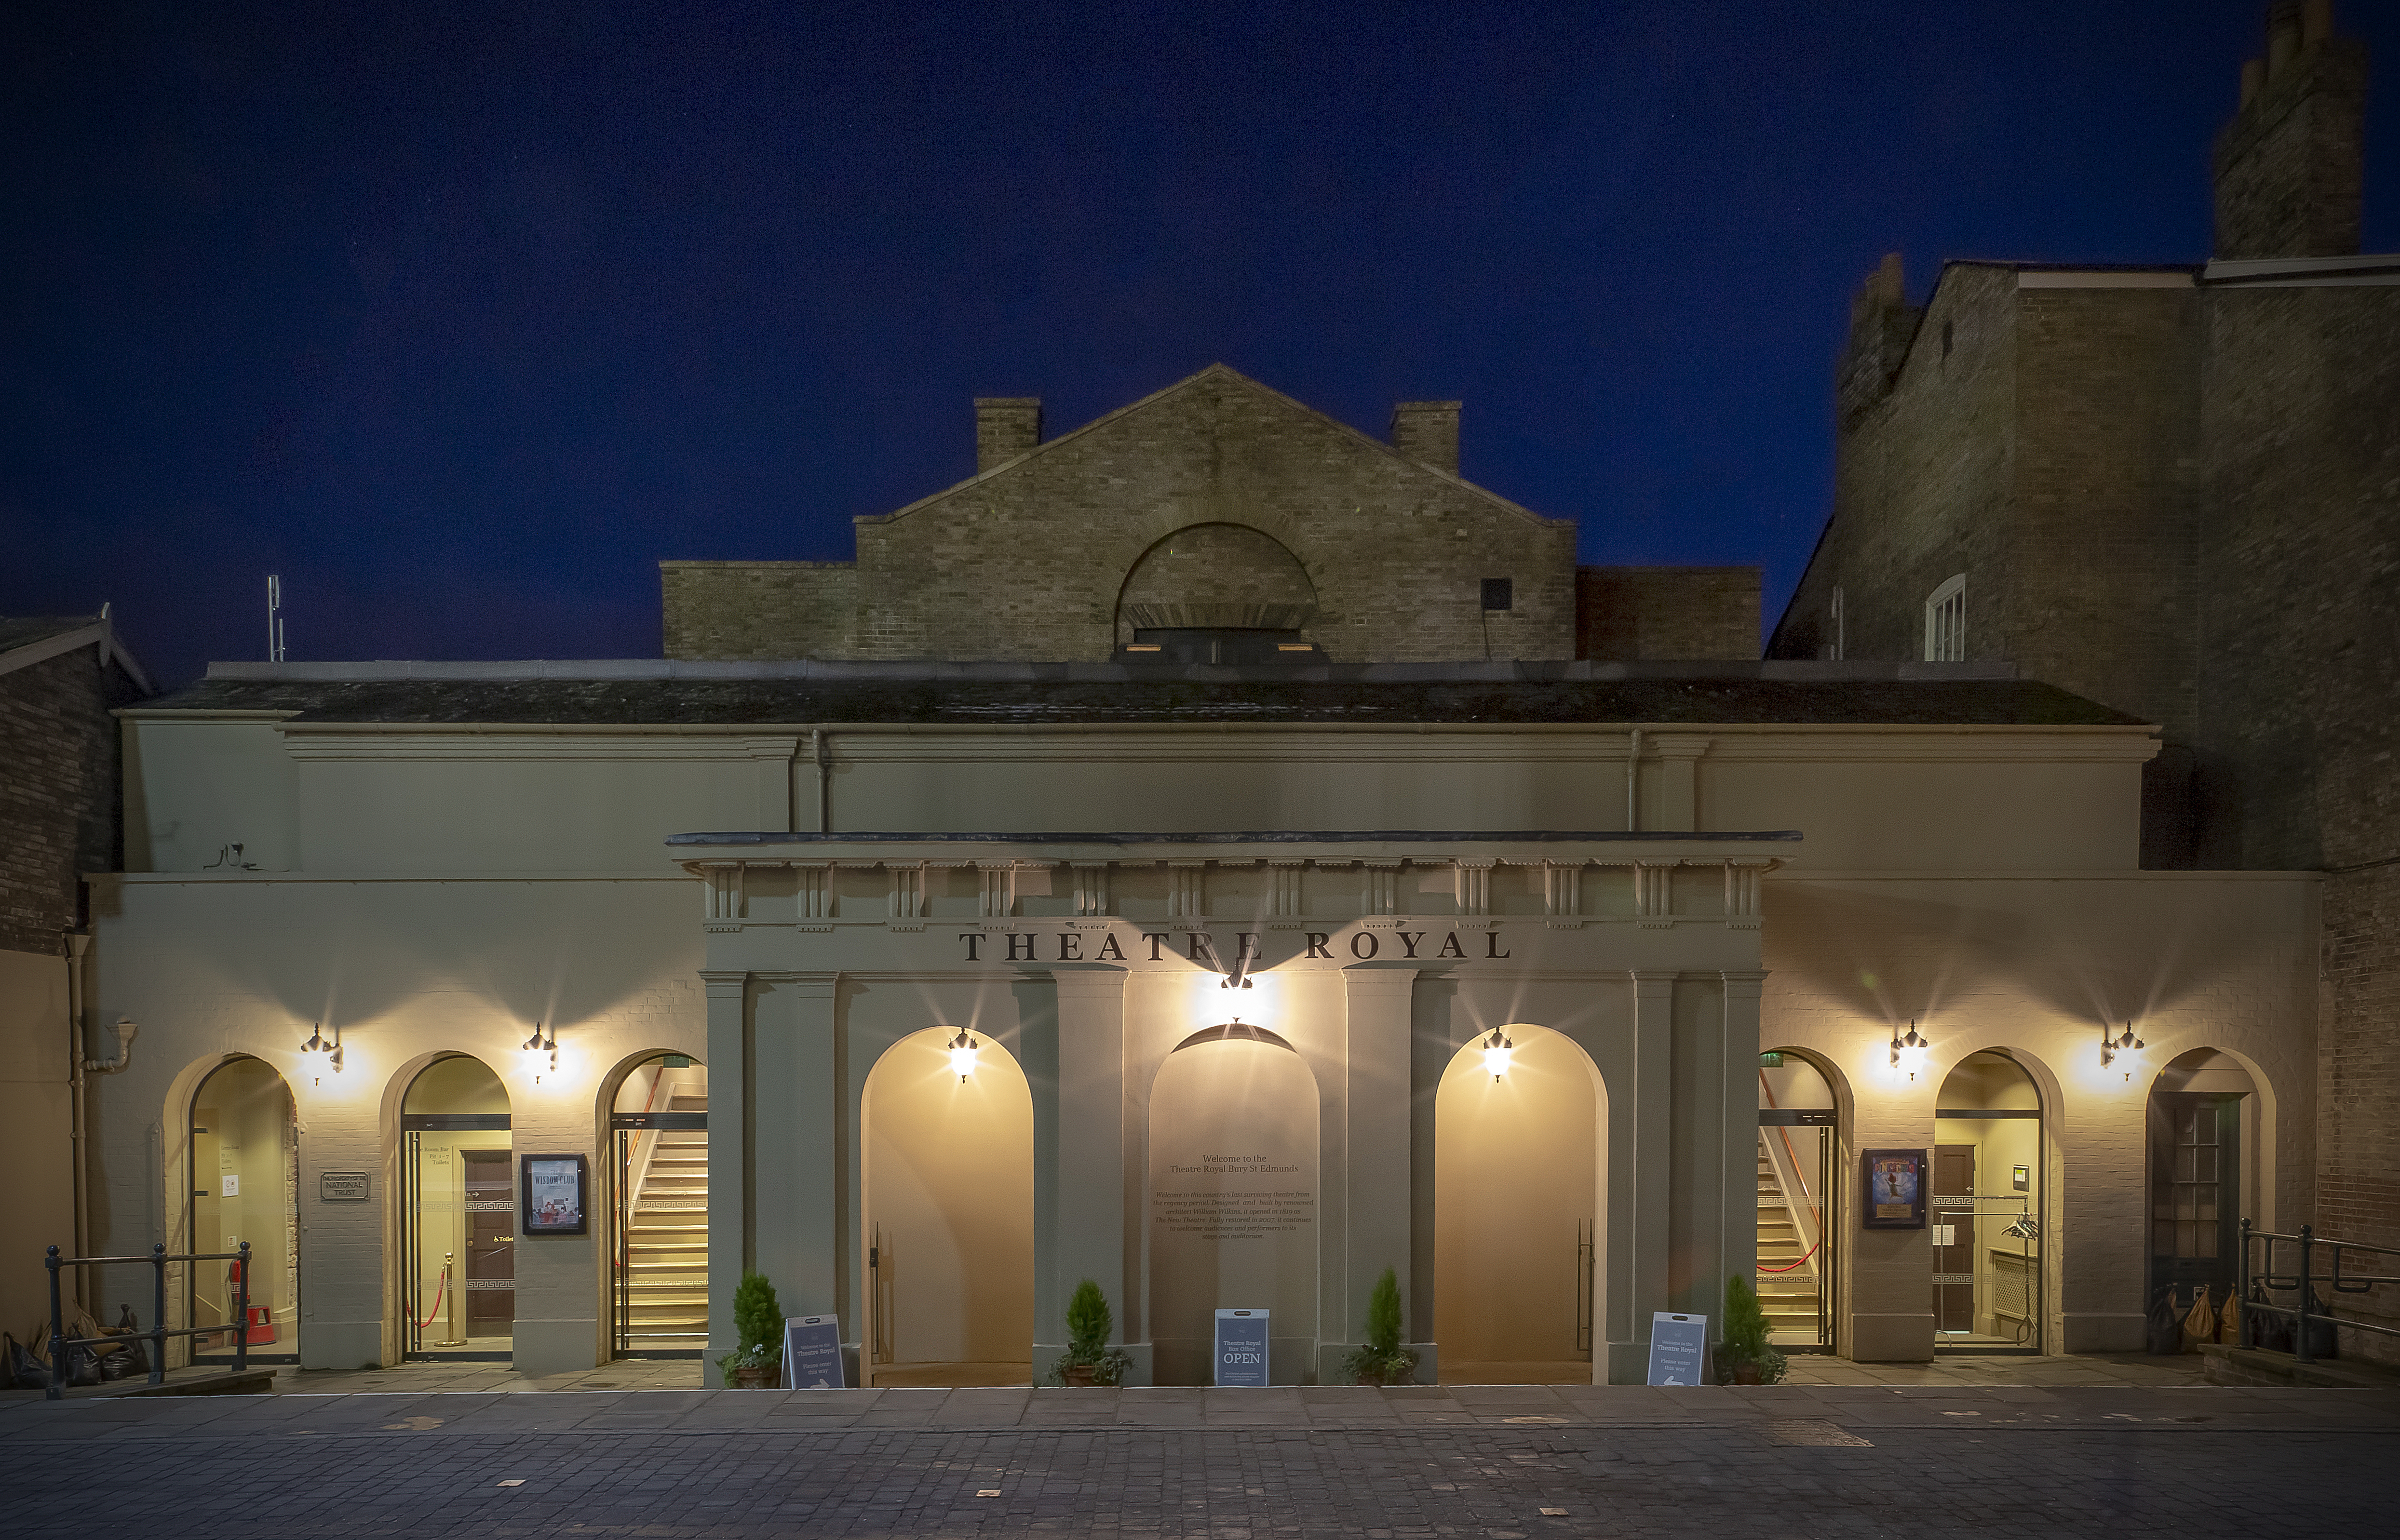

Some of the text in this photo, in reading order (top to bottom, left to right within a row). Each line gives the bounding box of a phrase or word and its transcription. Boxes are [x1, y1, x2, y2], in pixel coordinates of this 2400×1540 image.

[959, 931, 1511, 962] THEATRE ROYAL
[1202, 1154, 1240, 1163] Welcome
[1203, 1165, 1226, 1174] Royal
[1228, 1165, 1248, 1174] Bury
[535, 1175, 574, 1184] WISDOM CLUB
[1224, 1353, 1261, 1364] OPEN
